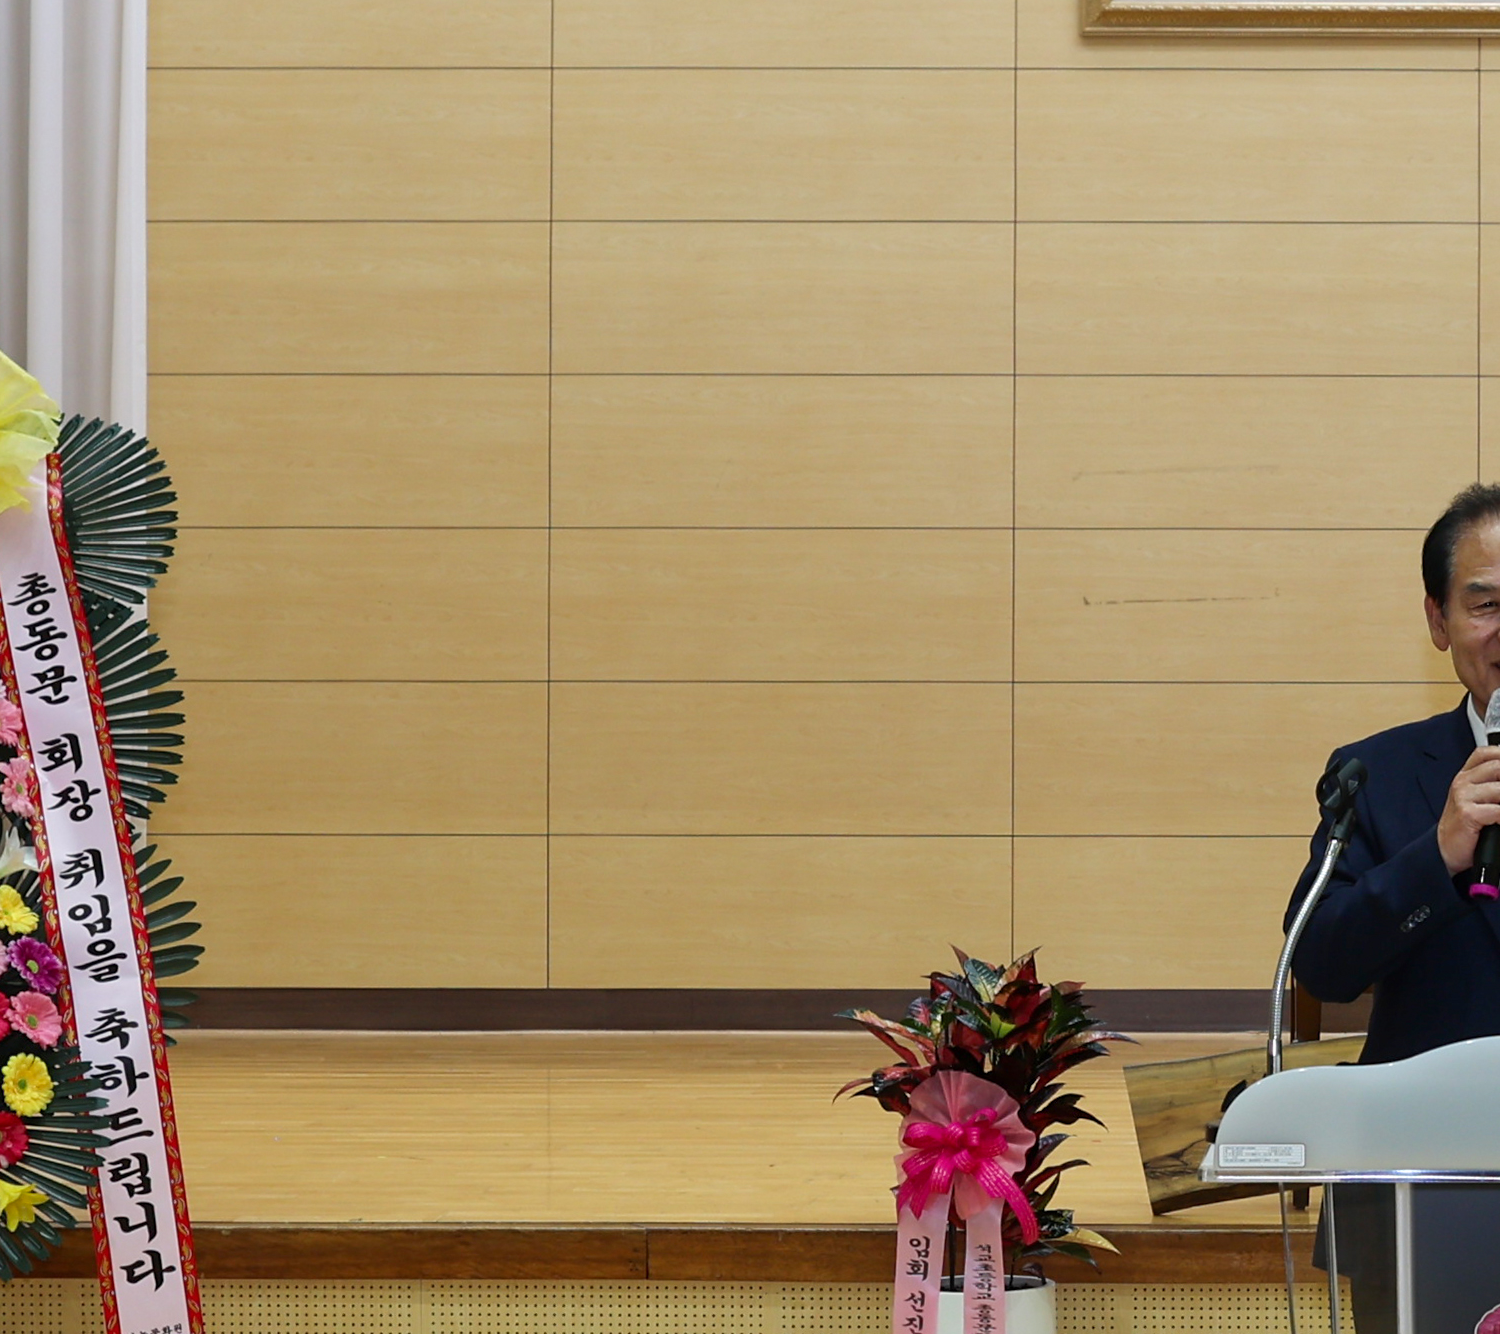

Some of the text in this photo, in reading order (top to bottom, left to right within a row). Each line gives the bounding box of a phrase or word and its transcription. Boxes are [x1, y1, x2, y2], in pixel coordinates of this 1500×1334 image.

[59, 848, 127, 983] 취임을
[84, 1008, 176, 1292] 축하드립니다
[906, 1236, 931, 1281] 임회
